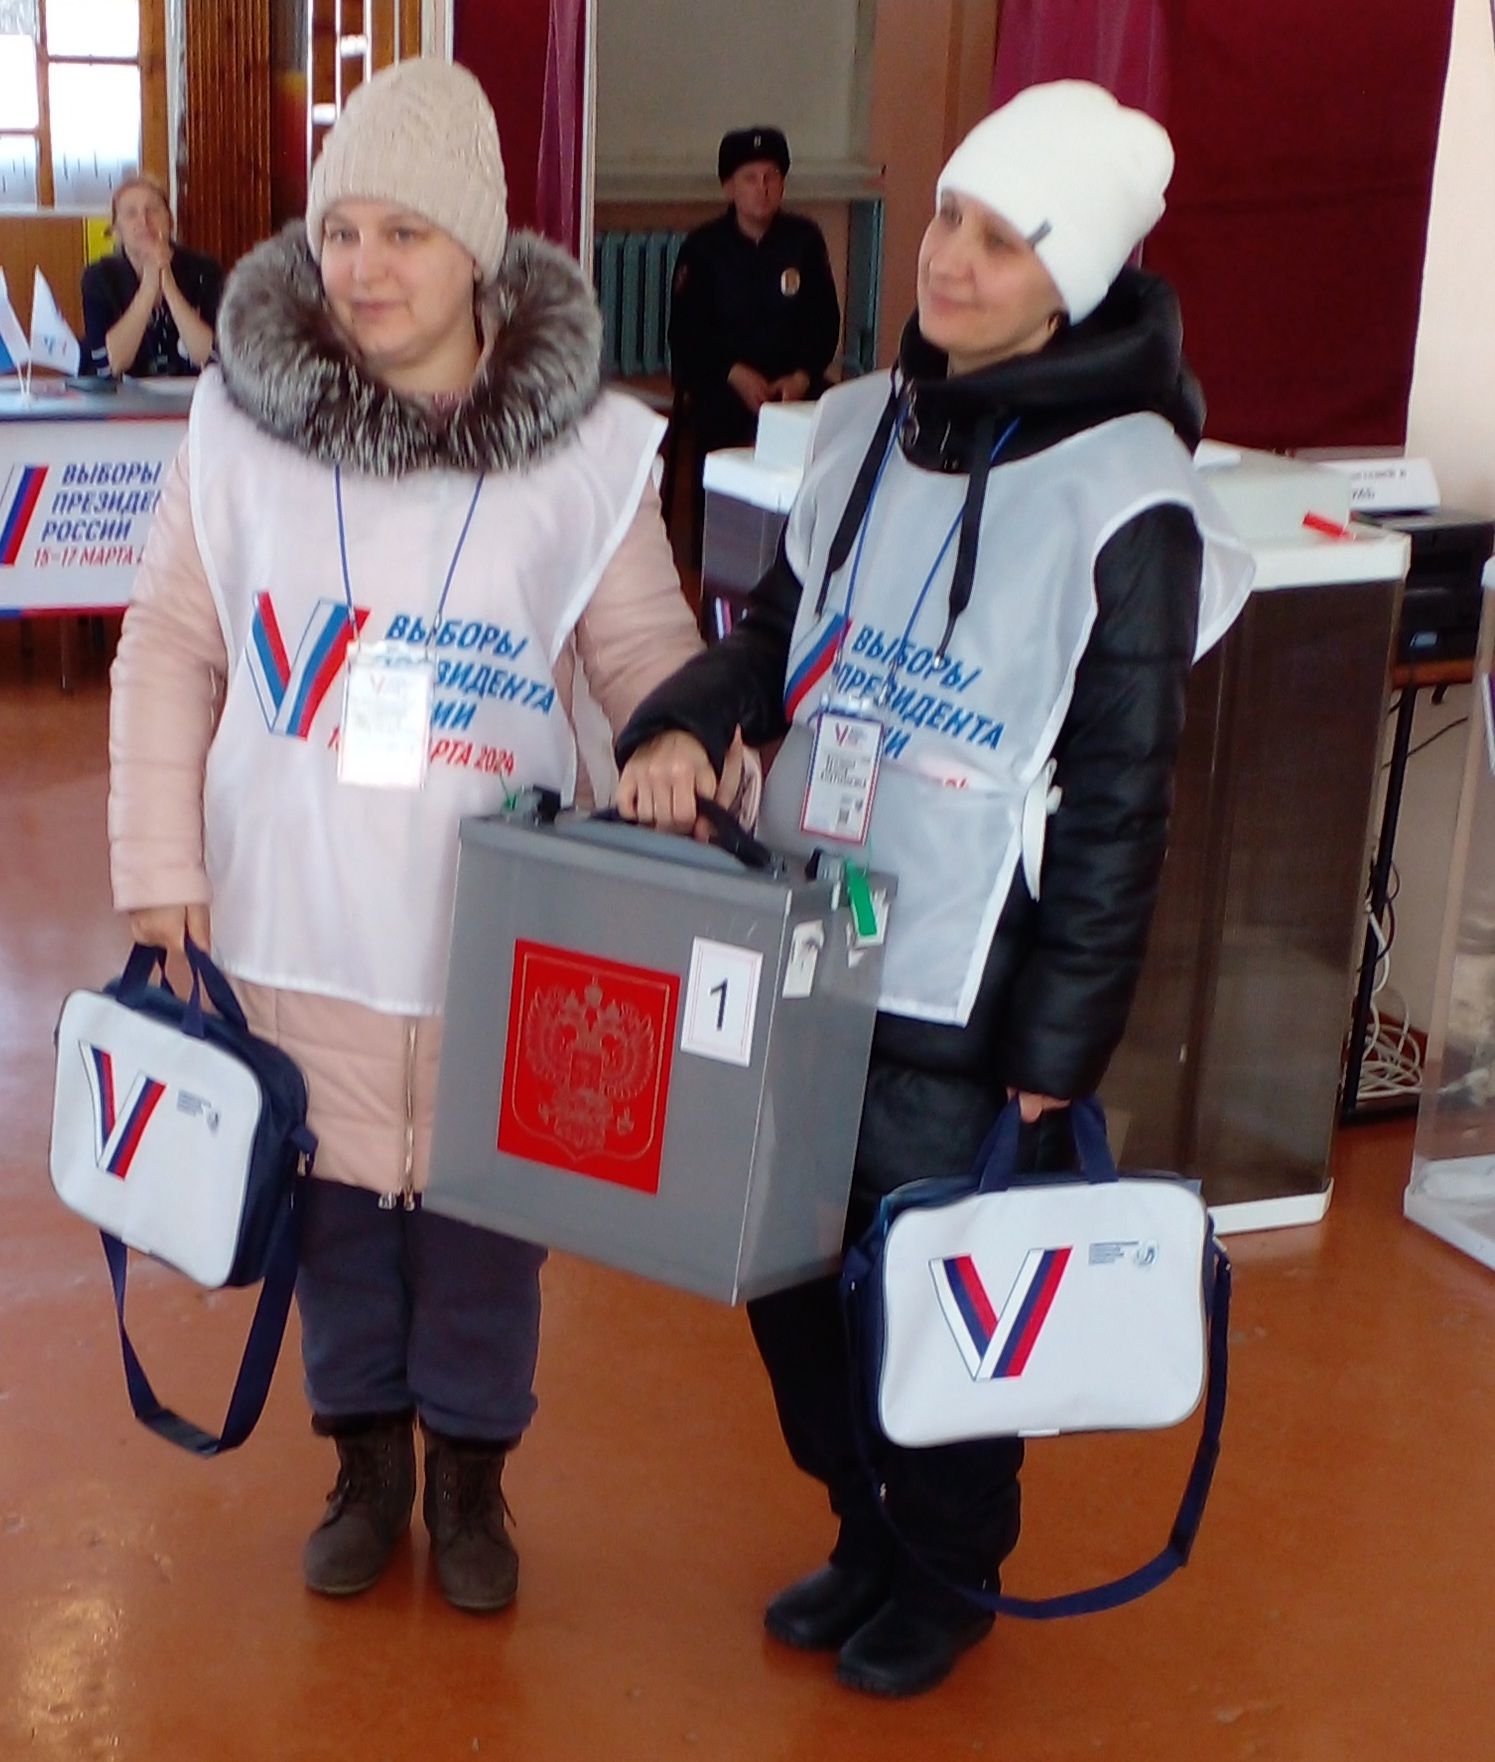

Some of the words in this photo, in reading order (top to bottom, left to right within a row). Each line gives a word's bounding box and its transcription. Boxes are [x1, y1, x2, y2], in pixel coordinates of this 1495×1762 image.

[62, 461, 162, 485] ВЫБОРЫ
[41, 519, 132, 542] РОССИИ
[34, 546, 77, 568] 15-17
[79, 546, 133, 567] МАРТА
[385, 614, 528, 661] ВЫБОРЫ
[852, 624, 982, 693] ВЫБОРЫ
[436, 660, 555, 715] ЗИДЕНТА
[430, 738, 473, 768] РТА
[474, 743, 515, 777] 2024
[709, 977, 728, 1031] 1
